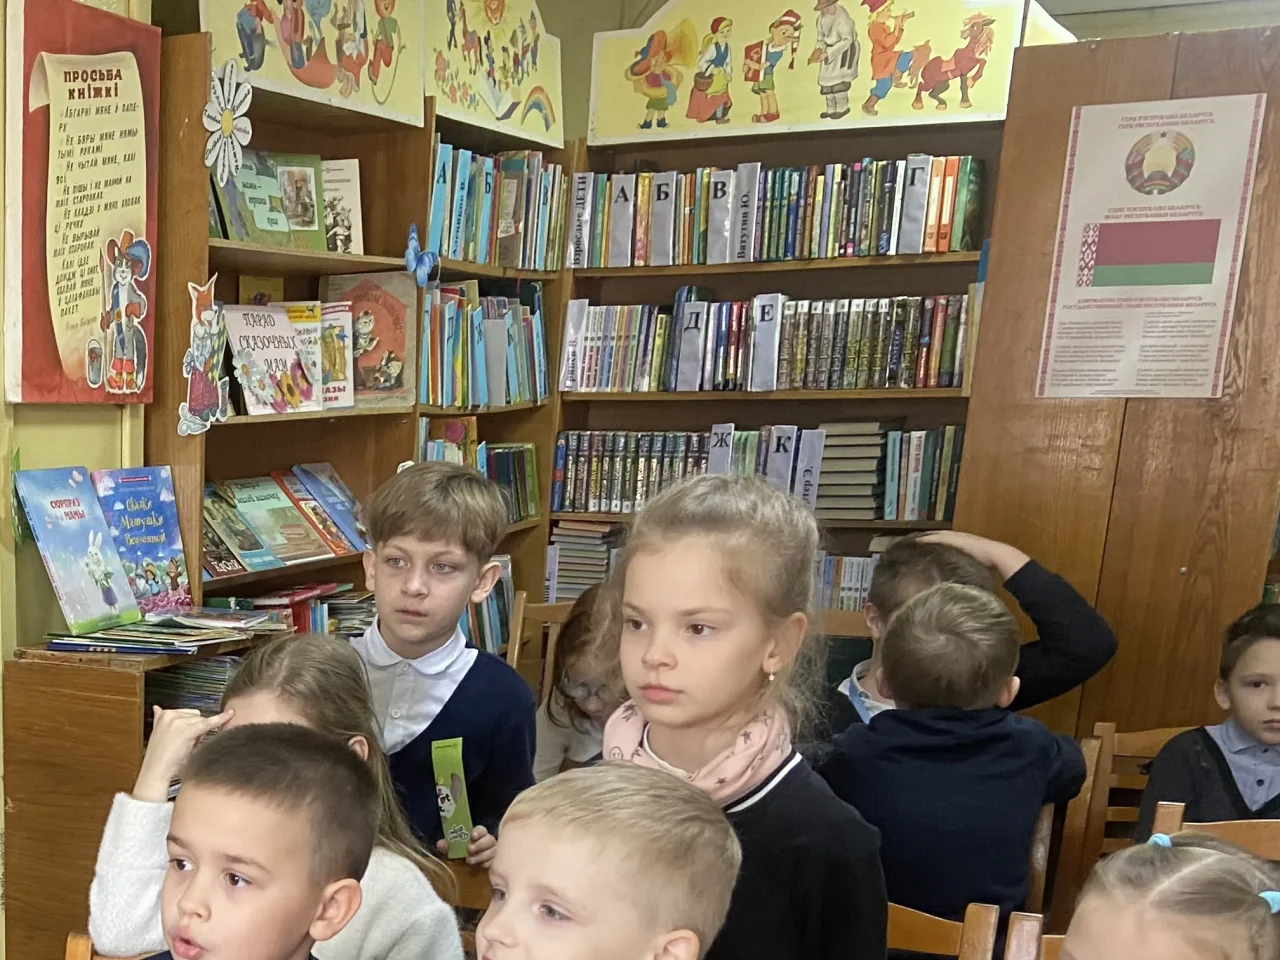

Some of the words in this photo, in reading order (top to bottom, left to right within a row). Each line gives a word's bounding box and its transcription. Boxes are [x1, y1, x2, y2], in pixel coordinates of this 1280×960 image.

[64, 69, 122, 83] ПРОСЬБА
[68, 82, 118, 100] КНІЖКІ
[64, 104, 91, 118] АБГАРНІ
[95, 105, 111, 115] МЯНЕ
[122, 102, 139, 112] ПАПЕ-
[58, 122, 67, 132] РУ
[77, 134, 95, 145] БЯРЫ
[99, 130, 115, 141] МЯНЕ
[80, 142, 103, 156] РУКАМІ
[78, 156, 98, 170] ЧЫТАЙ
[102, 155, 120, 165] МЯНЕ,
[437, 162, 447, 184] А
[908, 167, 925, 186] Г
[485, 172, 492, 194] Б
[712, 180, 727, 199] В
[72, 191, 103, 205] СТАРОНКАХ
[578, 175, 587, 210] ДЕТИ
[614, 185, 629, 203] А
[656, 182, 670, 201] Б
[103, 201, 119, 211] МЯНЕ
[737, 208, 750, 259] Ватутин
[60, 304, 79, 318] ПАКЕТ
[759, 304, 774, 322] Е
[242, 313, 276, 328] ПАРАД
[683, 311, 702, 332] Д
[239, 335, 298, 351] СКАЗОЧНЫХ
[263, 358, 289, 374] МАМ
[711, 432, 731, 448] Ж
[774, 435, 791, 454] К
[50, 497, 81, 509] СЮРПРИЗ
[63, 510, 86, 520] МАМЫ
